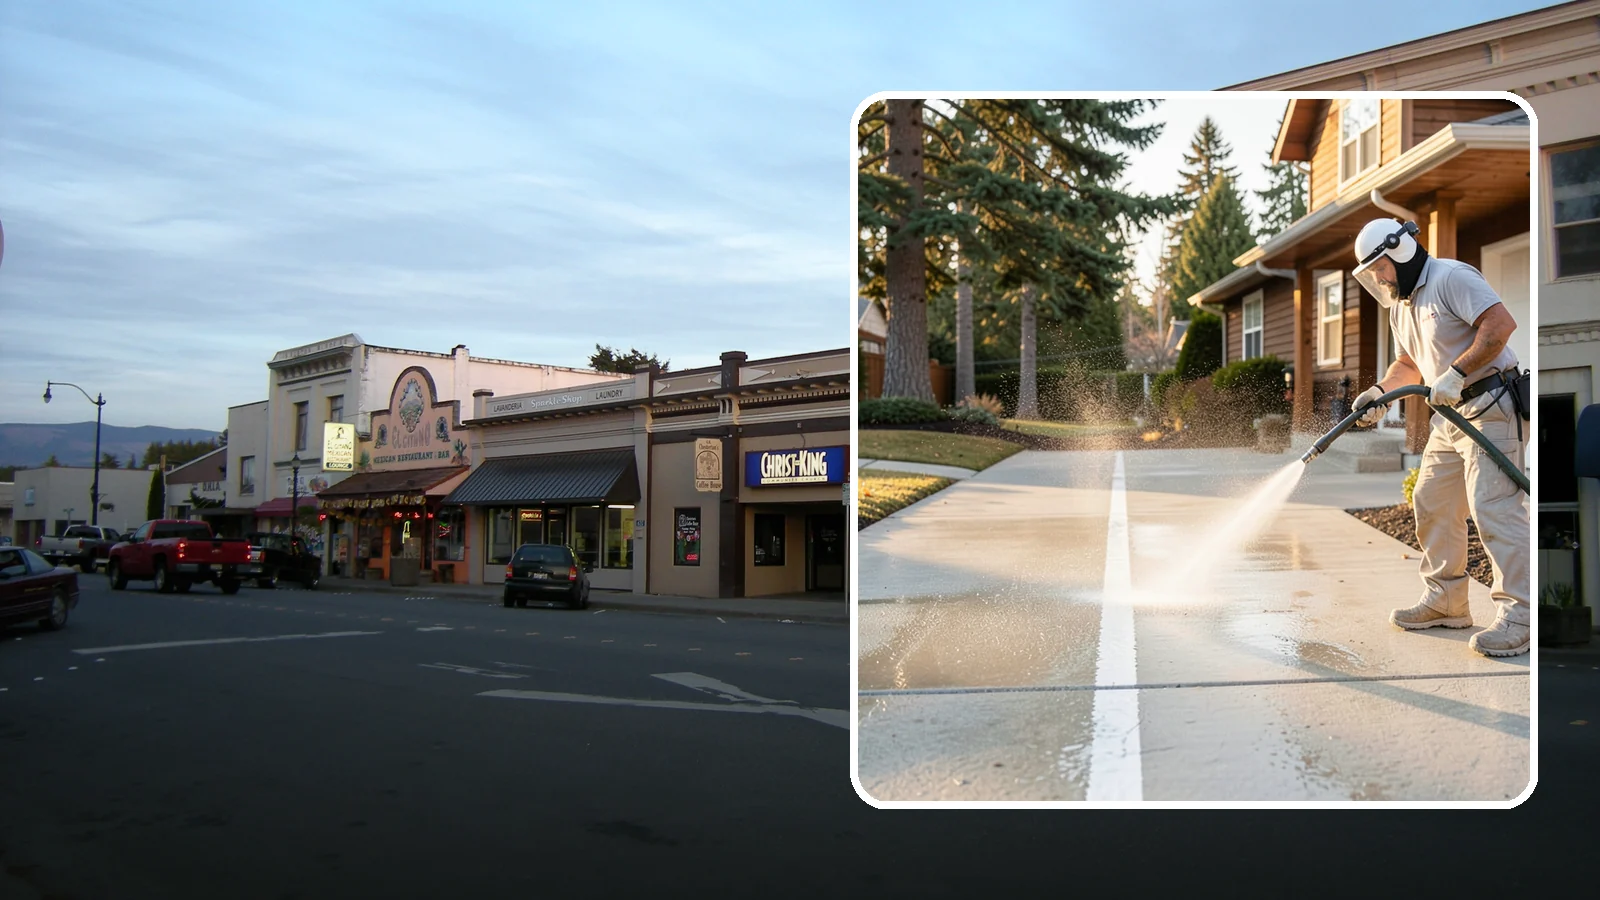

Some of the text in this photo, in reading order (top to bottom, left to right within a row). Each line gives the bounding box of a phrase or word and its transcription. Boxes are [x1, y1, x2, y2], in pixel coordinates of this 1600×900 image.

[595, 389, 623, 399] LAUNDRY
[562, 395, 582, 404] Shop
[493, 402, 522, 412] LAVANDERIA
[374, 450, 450, 464] MEXICAN RESTAURANT BAR
